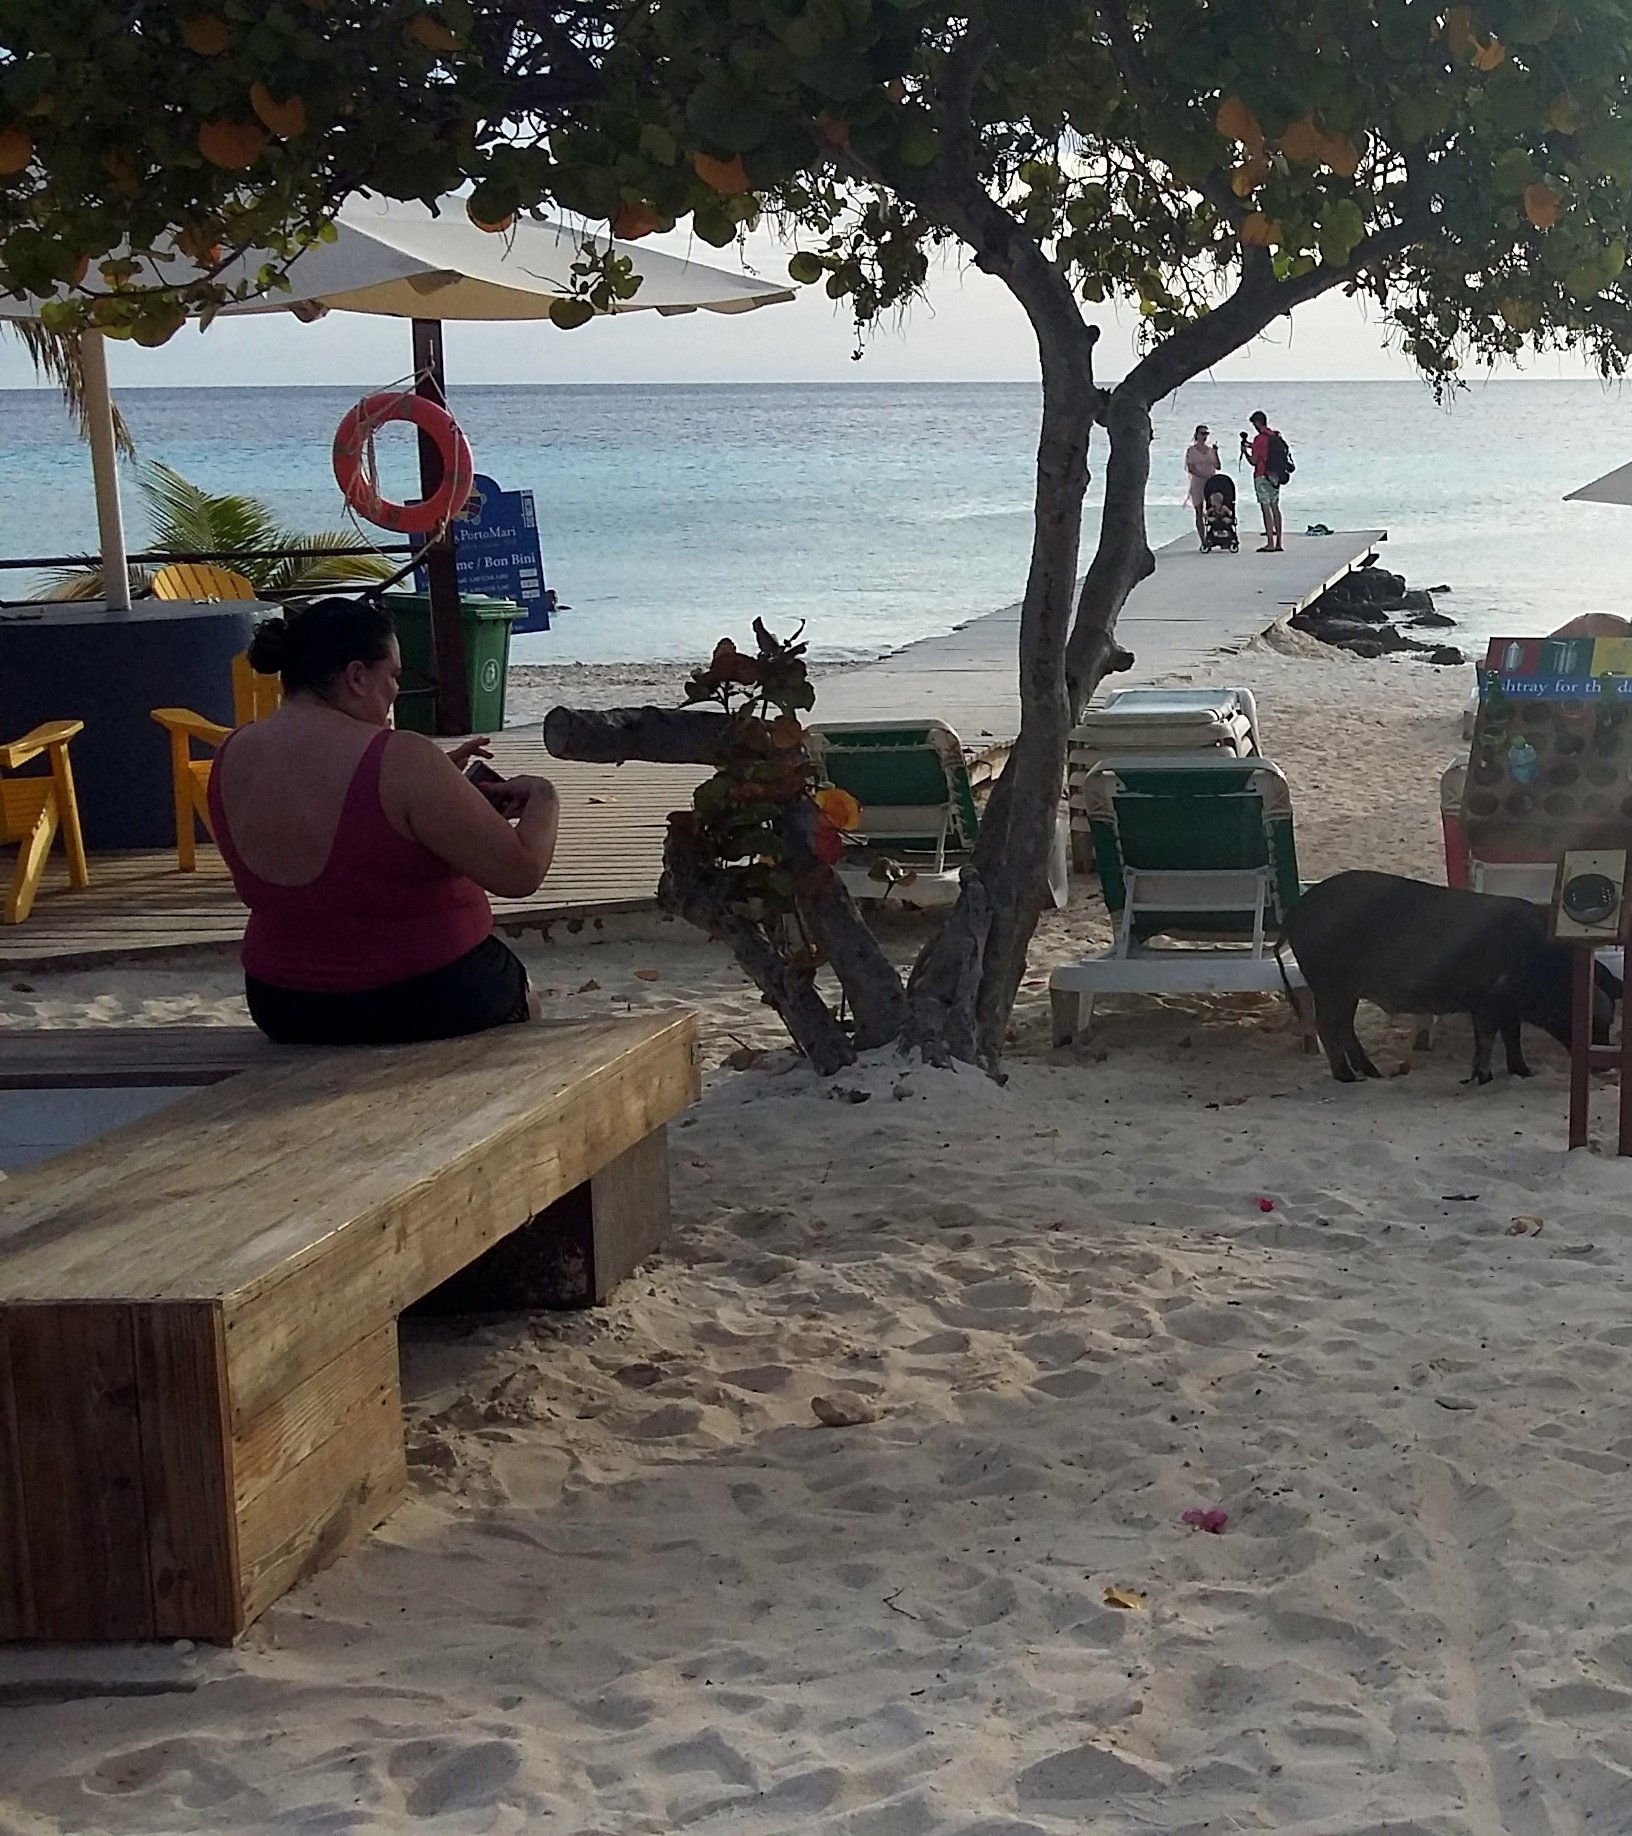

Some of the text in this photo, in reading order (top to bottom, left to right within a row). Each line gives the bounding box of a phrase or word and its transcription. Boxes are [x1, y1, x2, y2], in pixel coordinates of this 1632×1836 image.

[460, 526, 516, 541] PortoMari
[484, 555, 509, 568] Bon
[511, 552, 536, 566] Bini
[1555, 679, 1578, 692] for
